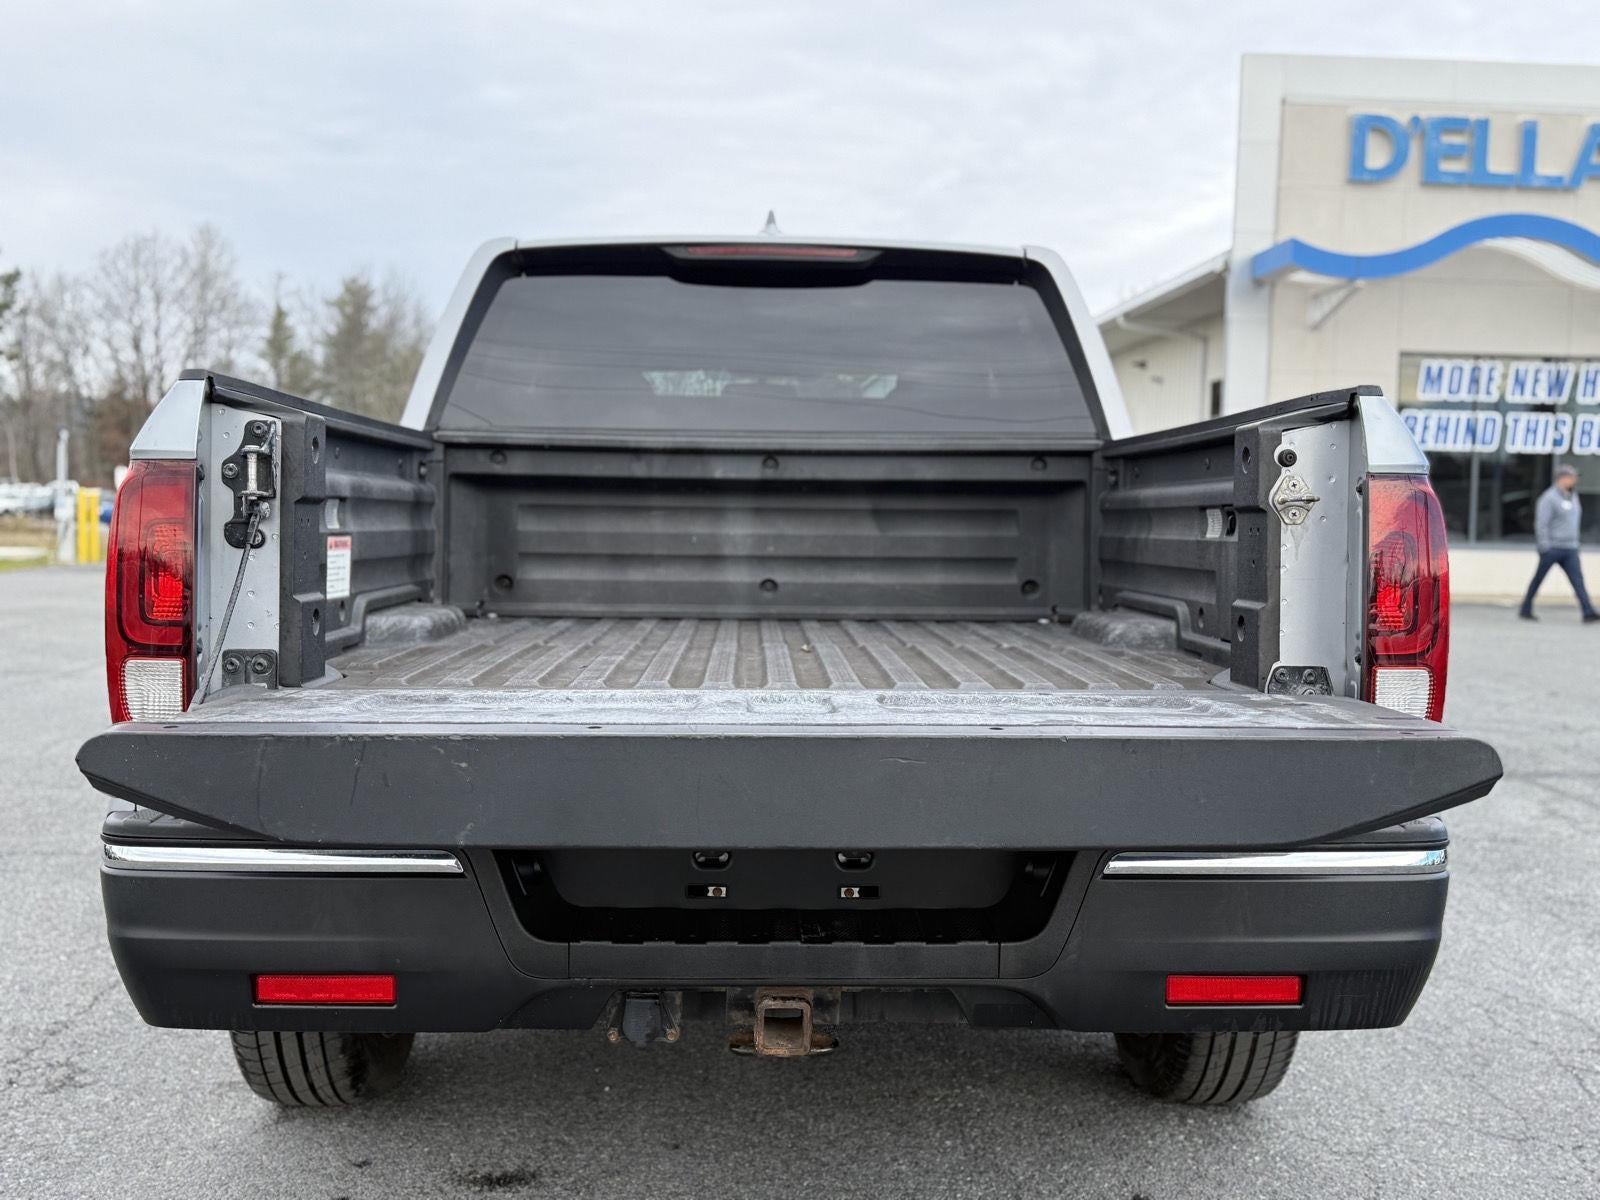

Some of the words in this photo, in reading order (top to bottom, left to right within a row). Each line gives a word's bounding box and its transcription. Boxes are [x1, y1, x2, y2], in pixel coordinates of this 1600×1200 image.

[1421, 364, 1499, 397] MORE
[1510, 366, 1570, 398] NEW
[1403, 415, 1498, 446] BEHIND
[1509, 417, 1567, 448] THIS
